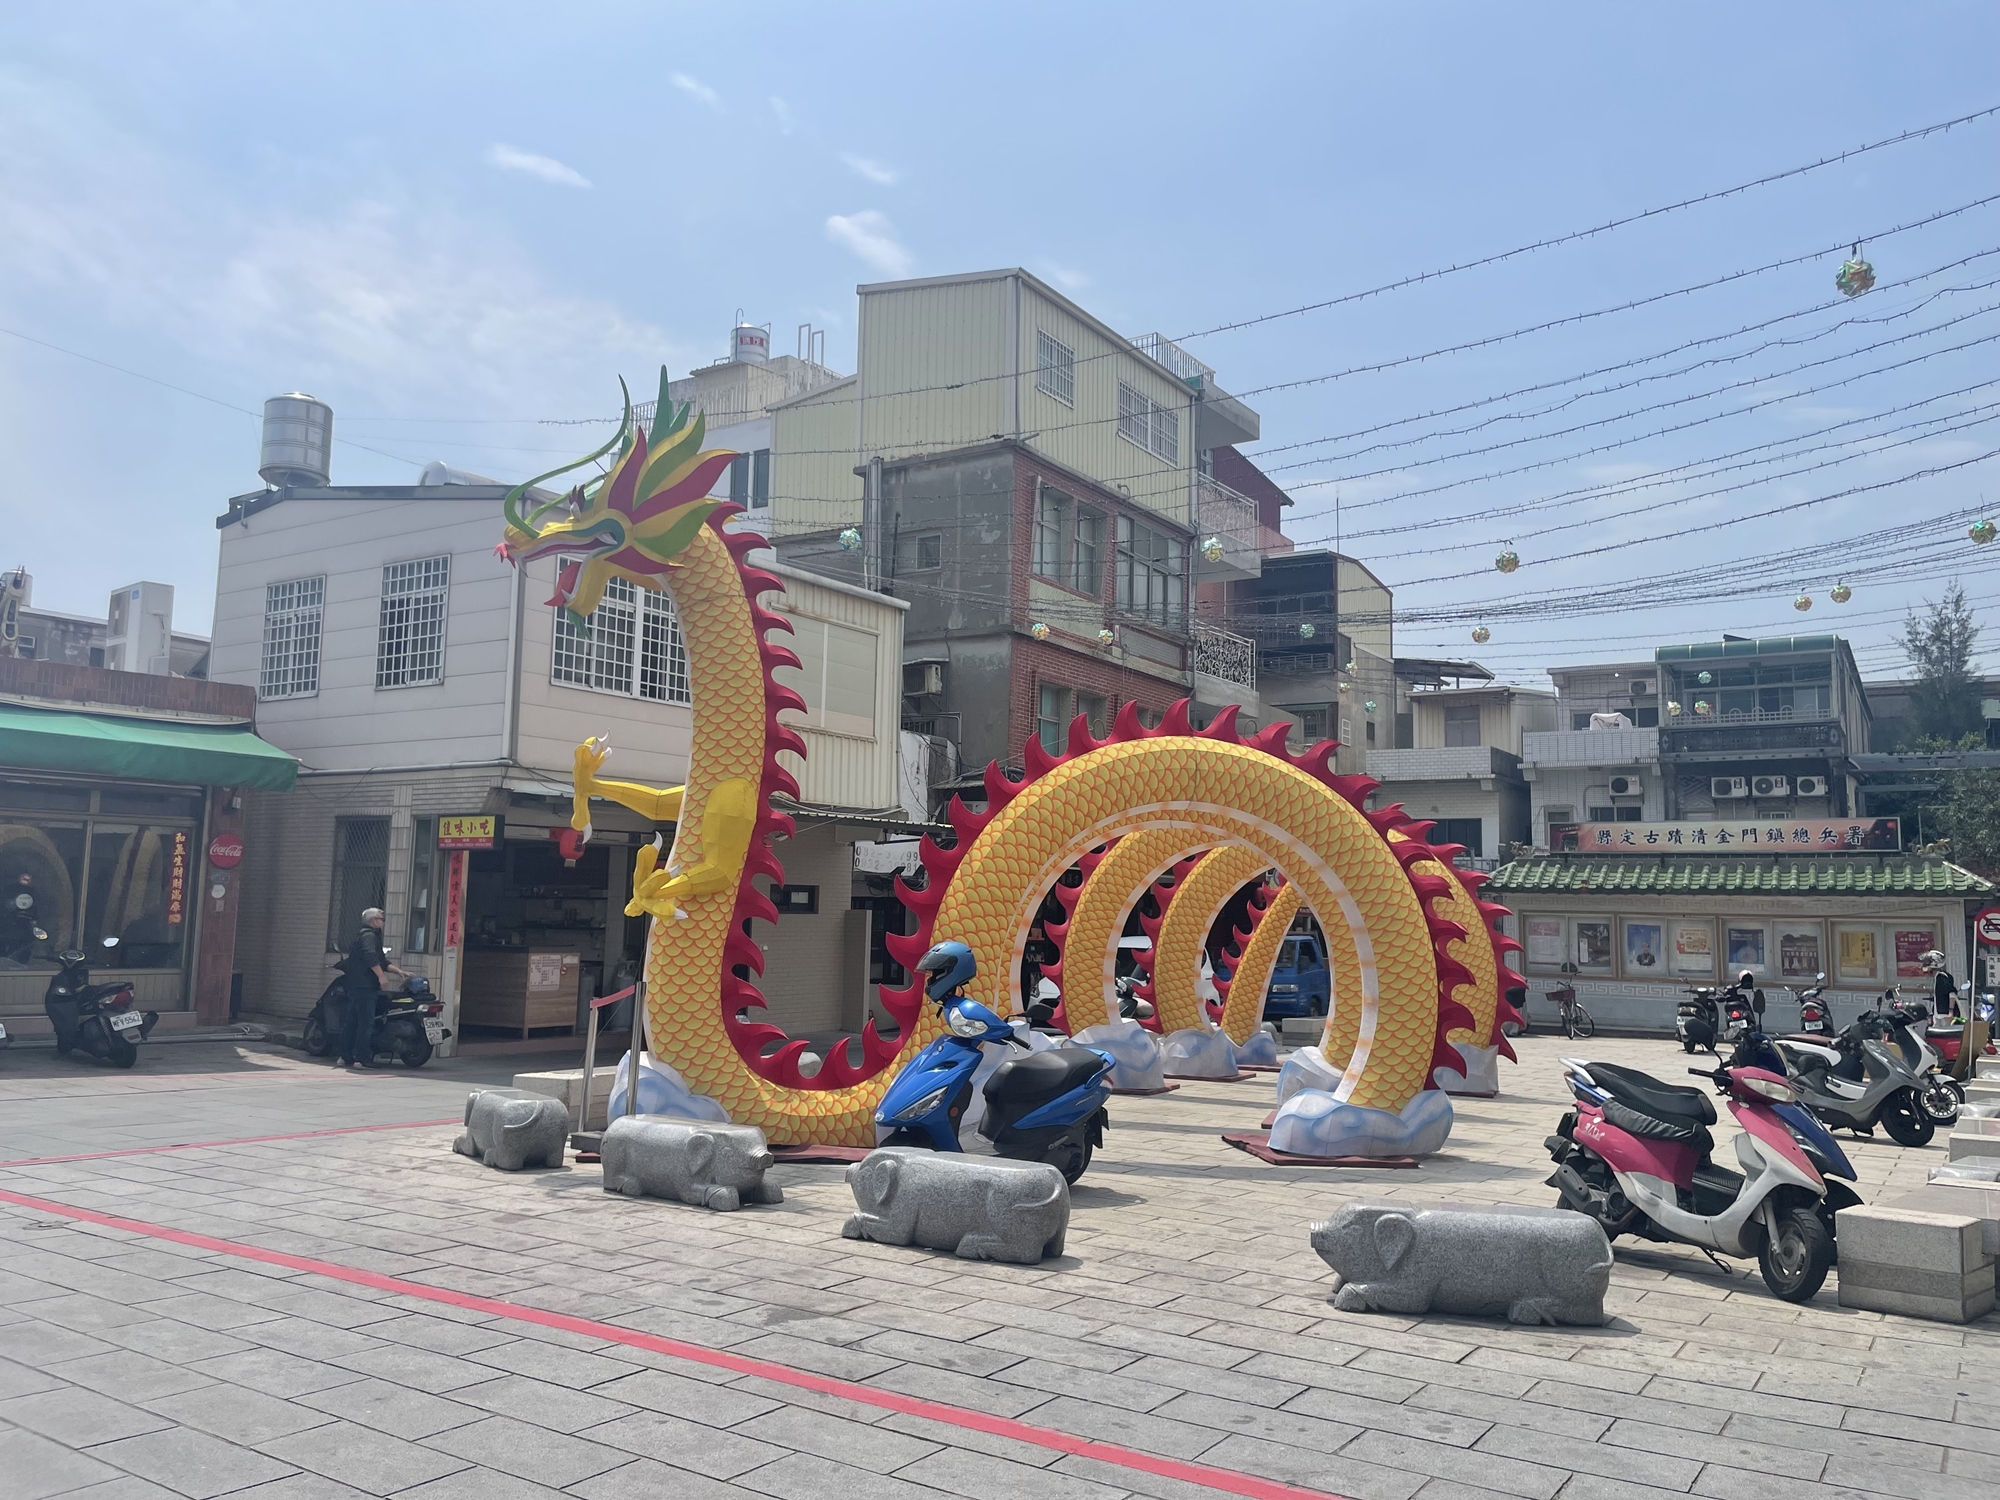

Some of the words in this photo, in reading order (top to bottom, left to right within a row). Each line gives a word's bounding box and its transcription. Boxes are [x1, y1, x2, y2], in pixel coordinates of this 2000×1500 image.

[443, 819, 490, 836] 佳味小吃
[1595, 826, 1866, 846] 縣定古蹟清金門鎮總兵署
